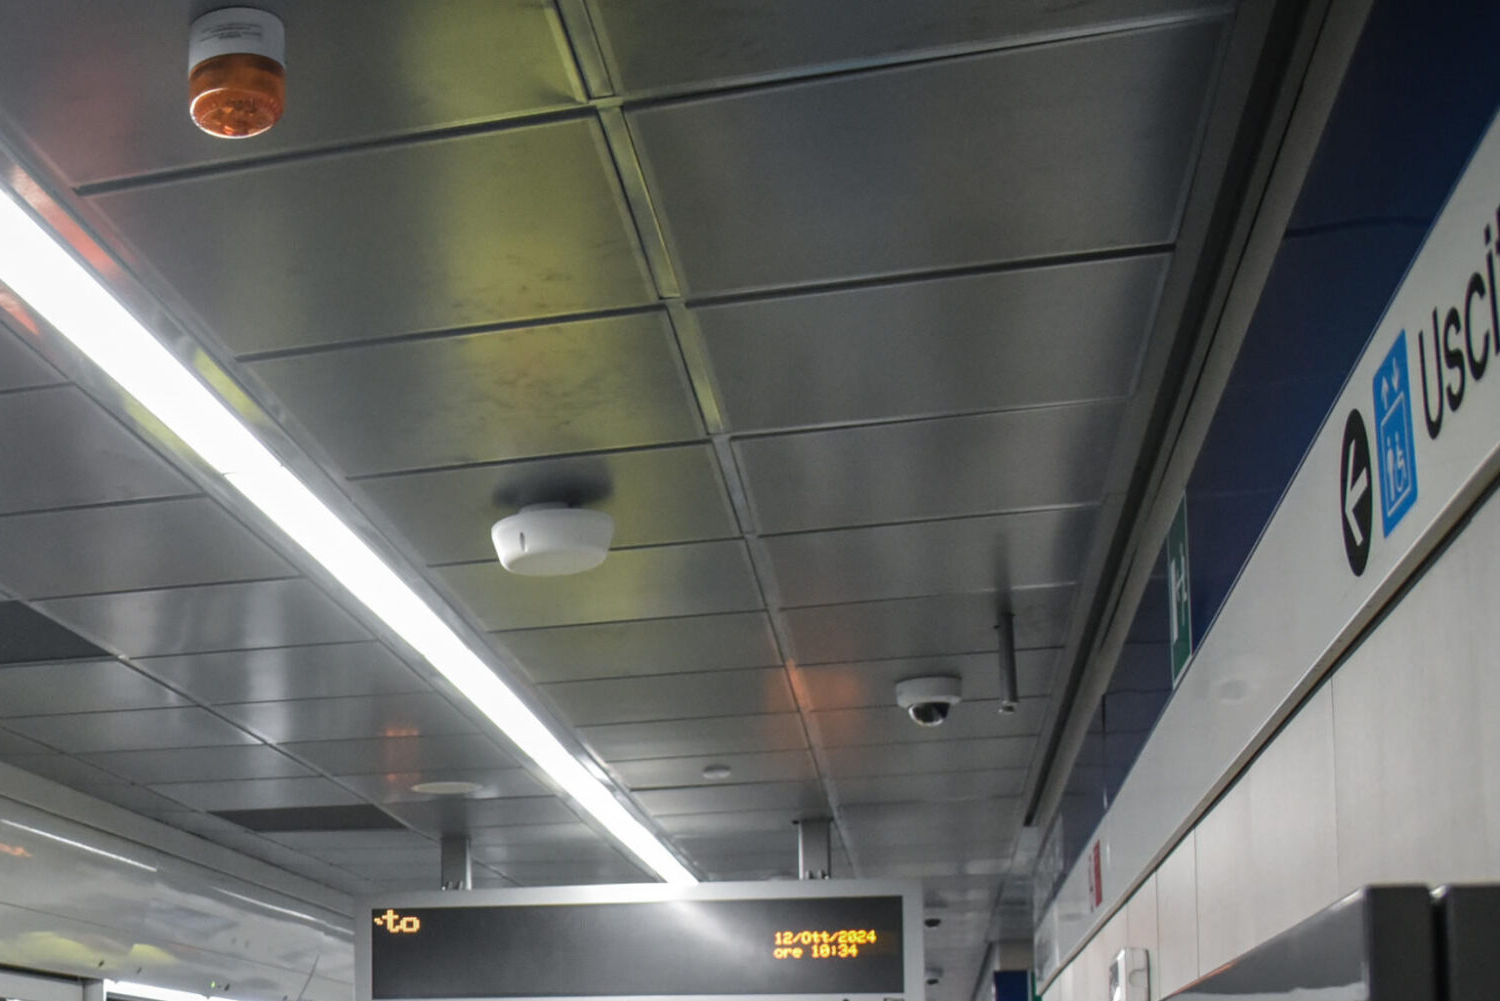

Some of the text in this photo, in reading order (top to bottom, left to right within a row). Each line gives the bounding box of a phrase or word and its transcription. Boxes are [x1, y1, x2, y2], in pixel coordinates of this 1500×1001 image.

[374, 909, 420, 933] to
[774, 929, 877, 945] 12/Ott/2024
[773, 943, 858, 959] ore 10:34
